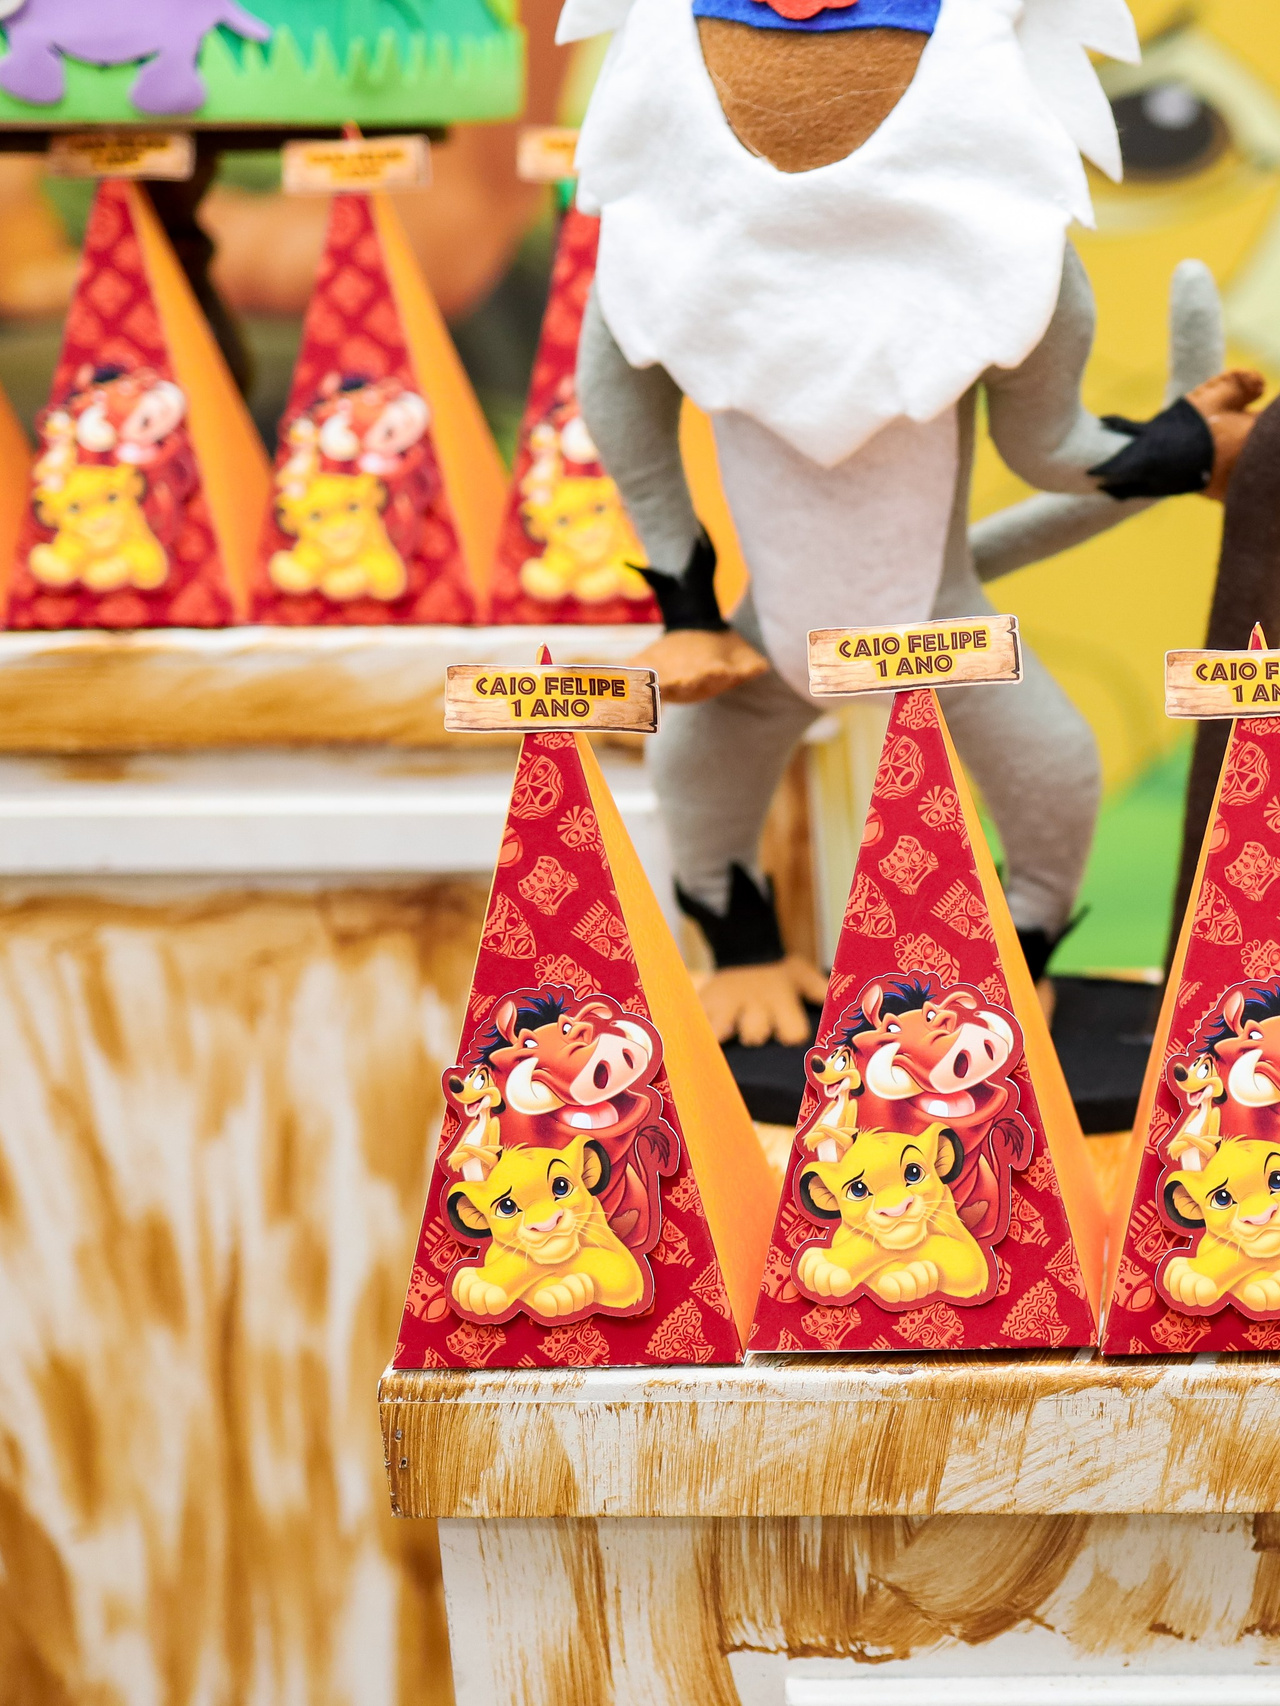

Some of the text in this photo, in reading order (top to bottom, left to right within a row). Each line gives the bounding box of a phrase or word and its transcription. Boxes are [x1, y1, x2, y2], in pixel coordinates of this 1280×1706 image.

[839, 630, 987, 658] CAIO FELIPE
[876, 654, 953, 677] 1 ANO
[1196, 662, 1257, 682] CAIO
[476, 677, 626, 697] CAIO FELIPE
[1232, 684, 1243, 703] 1
[511, 698, 590, 717] 1 ANO
